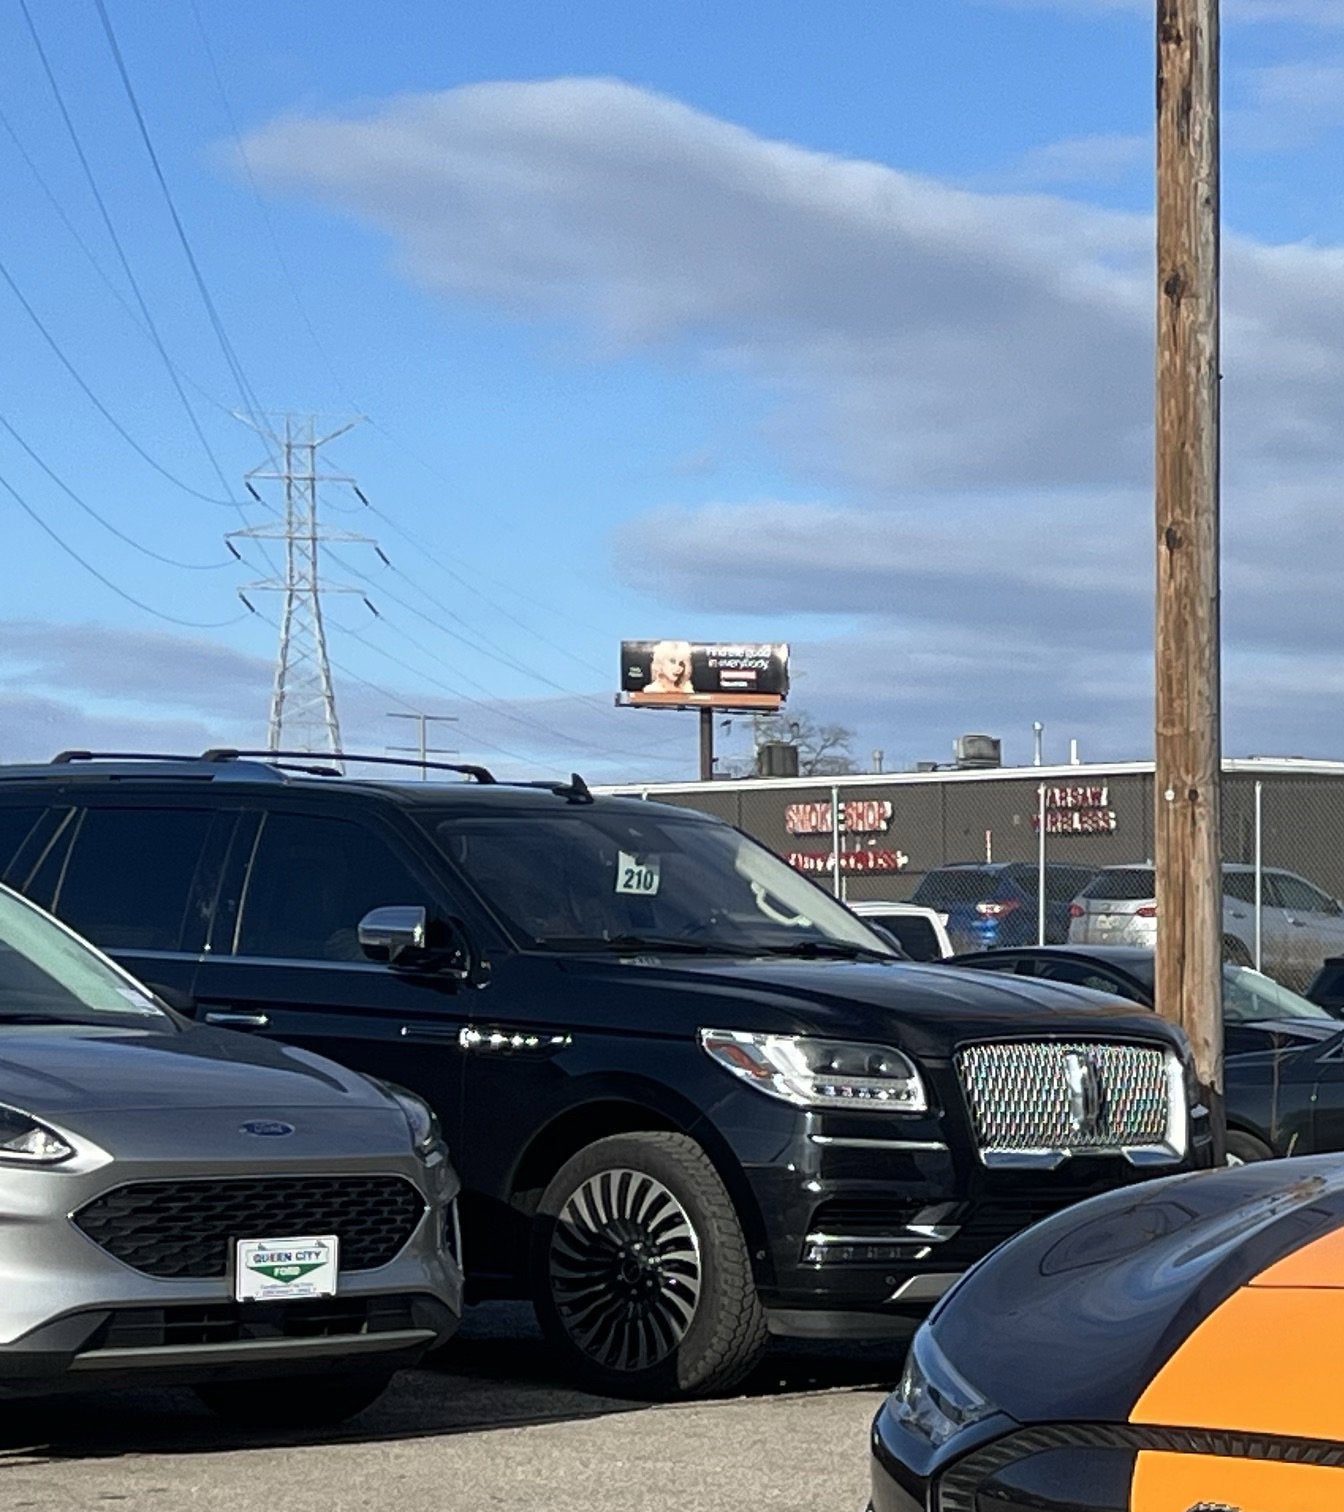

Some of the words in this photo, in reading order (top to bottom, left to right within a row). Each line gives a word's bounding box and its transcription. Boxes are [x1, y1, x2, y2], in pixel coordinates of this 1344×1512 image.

[785, 803, 846, 833] SMOKE
[845, 801, 892, 832] SHOP
[623, 867, 654, 890] 210
[253, 1252, 292, 1264] QUEEN
[296, 1250, 321, 1261] CITY
